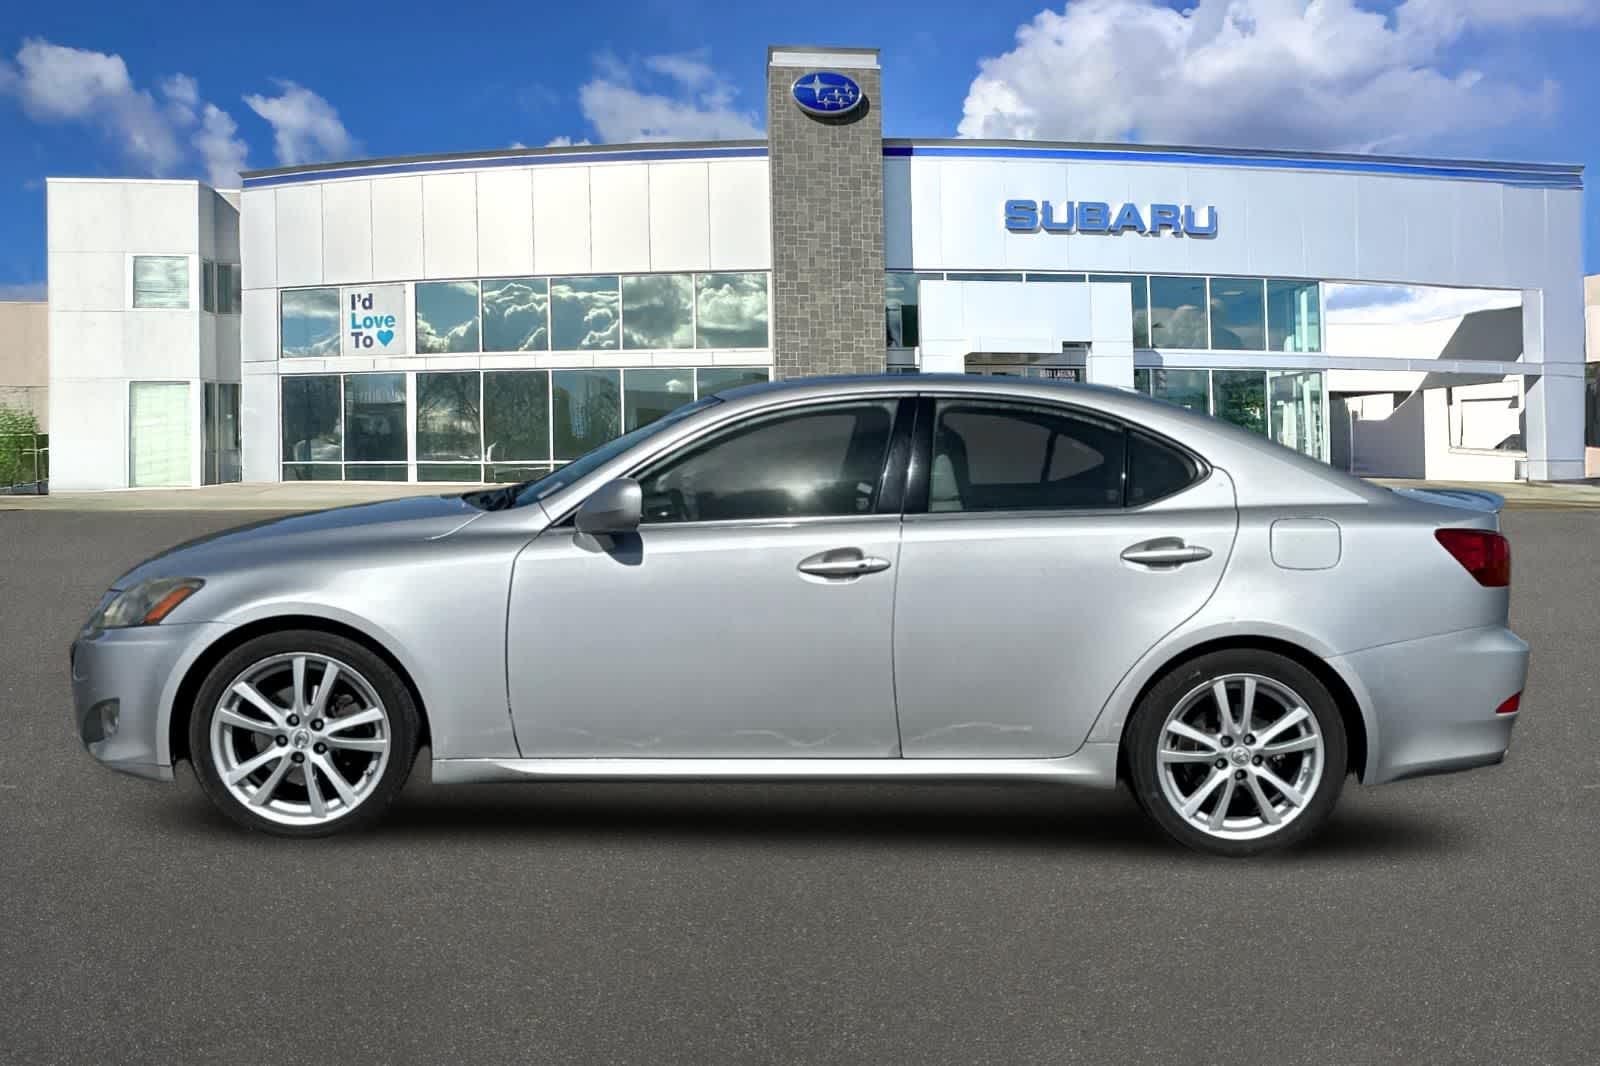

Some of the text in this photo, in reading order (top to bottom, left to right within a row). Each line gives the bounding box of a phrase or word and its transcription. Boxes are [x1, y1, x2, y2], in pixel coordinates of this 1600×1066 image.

[1005, 199, 1217, 238] SUBARU
[351, 293, 373, 310] I'd
[351, 313, 396, 329] Love
[351, 332, 374, 348] To
